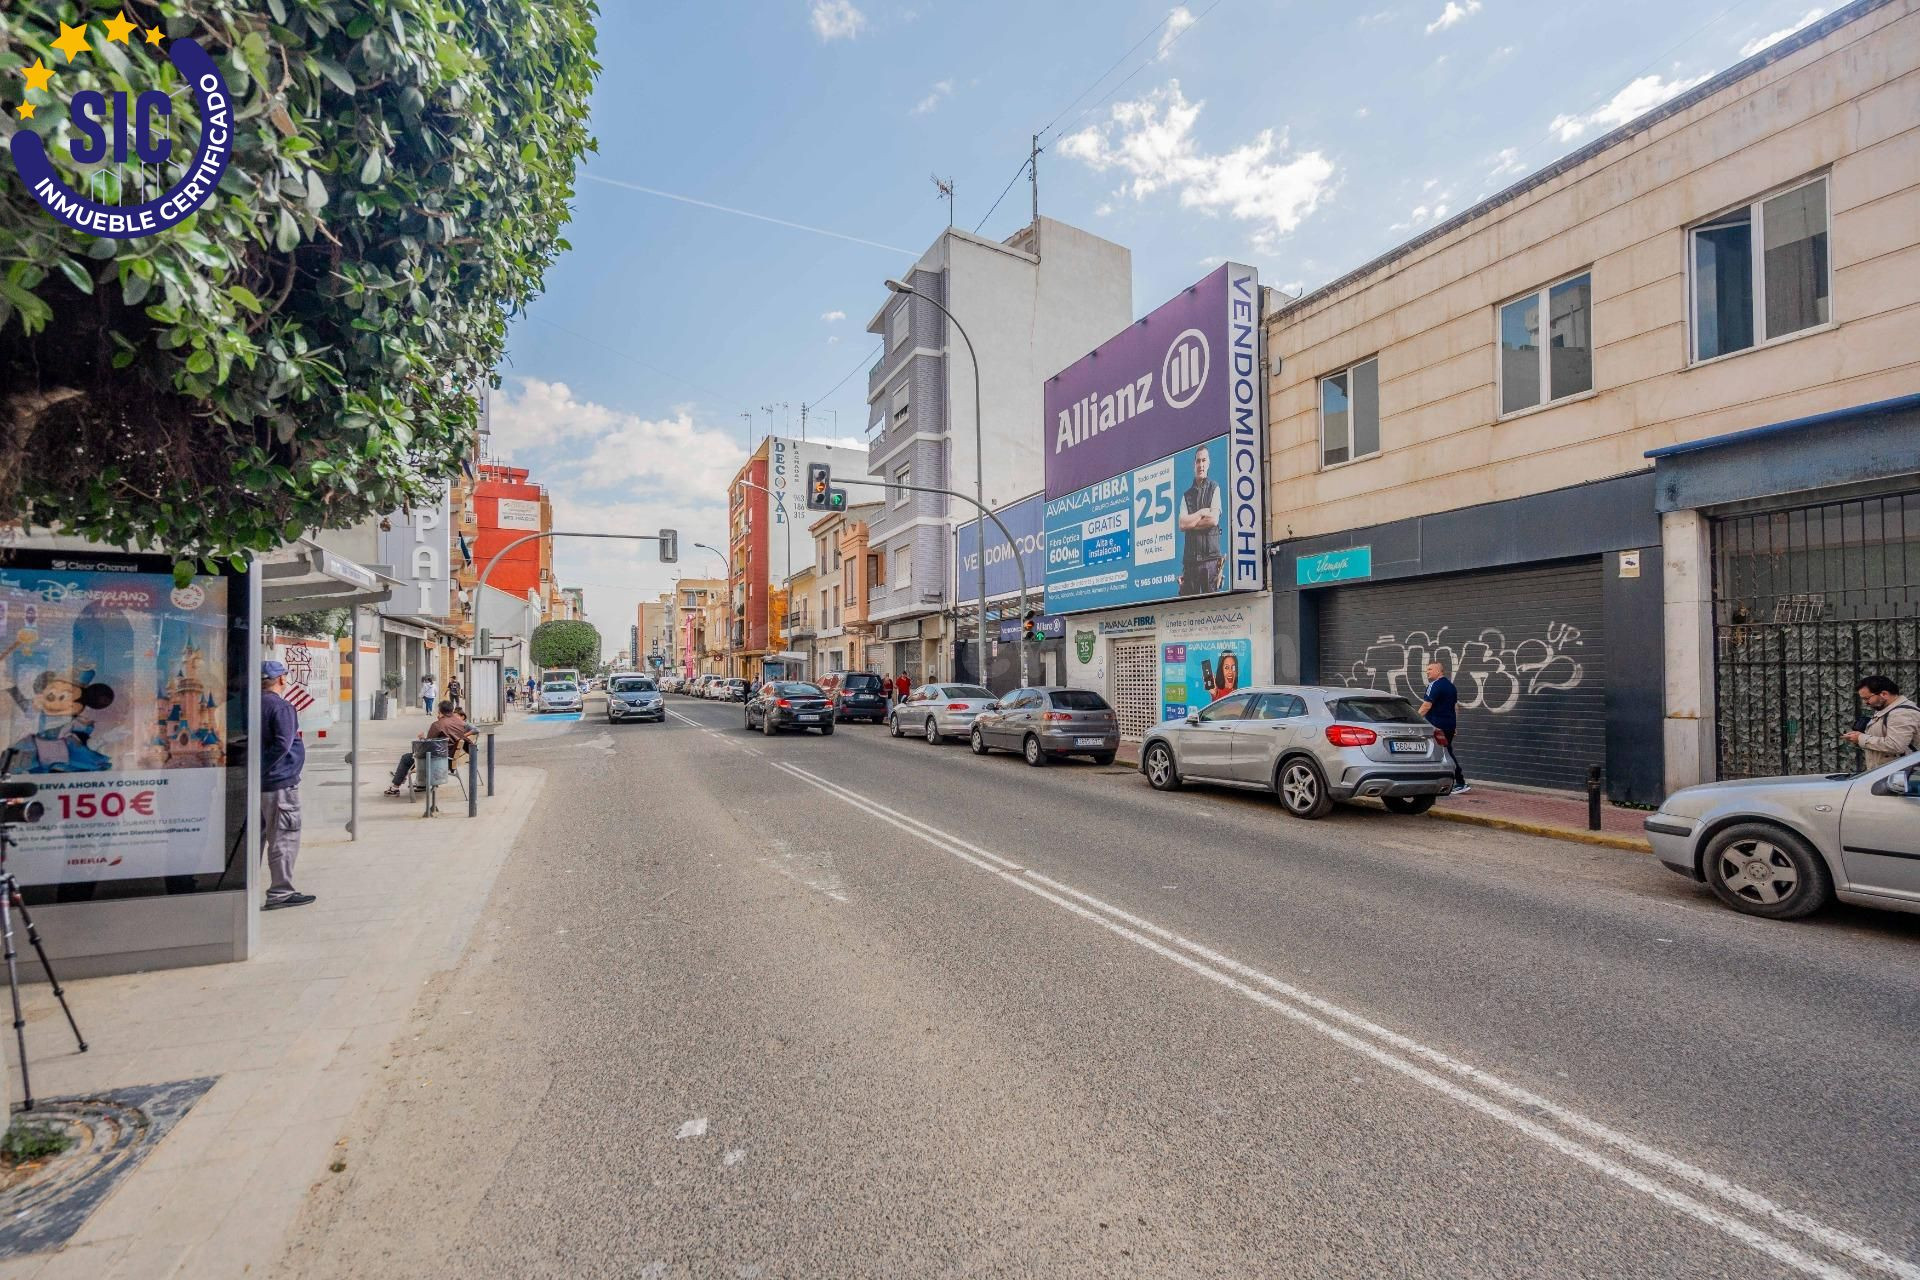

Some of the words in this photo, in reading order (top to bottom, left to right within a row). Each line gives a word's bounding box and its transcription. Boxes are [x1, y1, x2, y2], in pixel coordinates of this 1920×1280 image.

[1055, 372, 1154, 455] Allianz
[1233, 276, 1258, 581] VENDOMICOCHE
[775, 442, 786, 524] DECOVAL
[1045, 492, 1091, 518] AVANZA
[1091, 476, 1129, 503] FIBRA
[1135, 481, 1172, 528] 25
[793, 511, 805, 519] 315
[1088, 514, 1122, 535] GRATIS
[1136, 538, 1153, 547] euros
[1158, 533, 1173, 542] mes
[1088, 544, 1121, 559] instalación
[68, 562, 95, 571] Clear
[96, 562, 138, 572] Channel
[1133, 615, 1156, 627] FIBRA
[1206, 612, 1244, 624] AVANZA
[39, 782, 65, 791] ERVA
[69, 781, 105, 789] AHORA
[108, 780, 115, 788] Y
[116, 779, 169, 787] CONSIGUE
[58, 790, 155, 820] 150€
